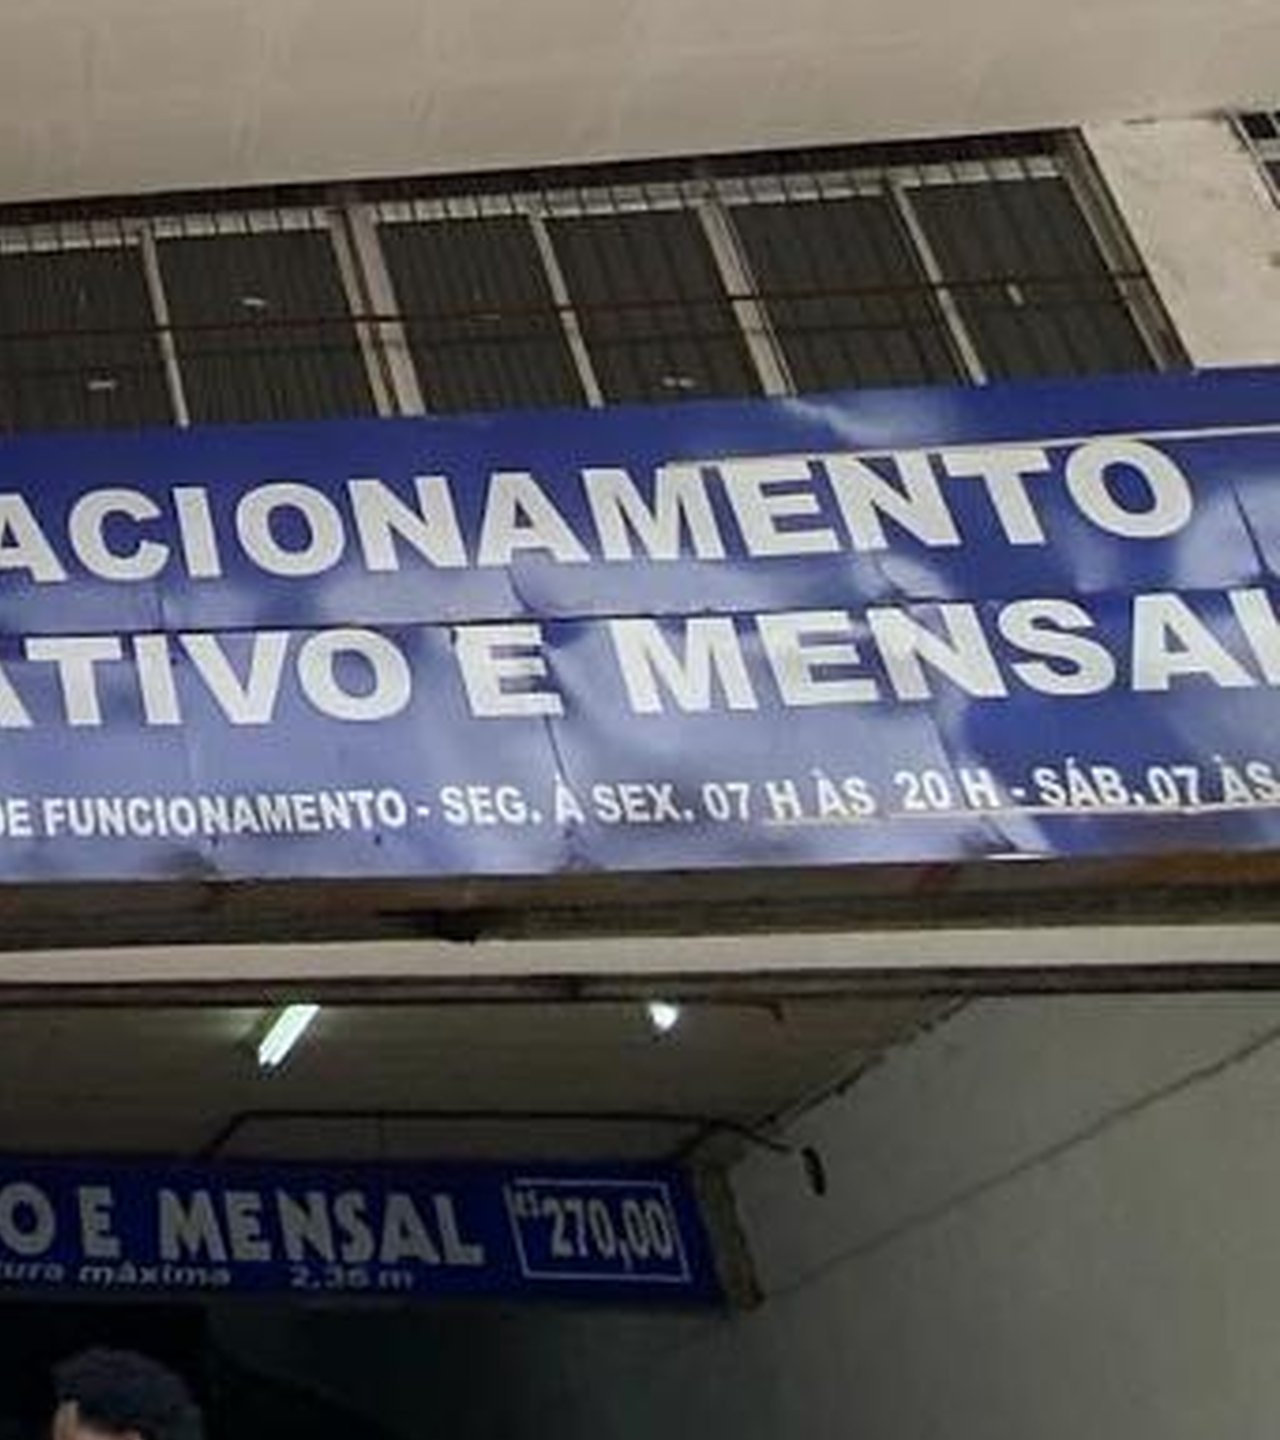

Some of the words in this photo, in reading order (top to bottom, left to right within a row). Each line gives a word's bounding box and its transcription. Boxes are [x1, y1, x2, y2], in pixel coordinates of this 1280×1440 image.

[453, 622, 565, 718] E
[43, 787, 407, 841] FUNCIONAMENTO
[703, 782, 750, 820] 07
[766, 780, 803, 817] H
[894, 769, 952, 810] 20
[959, 768, 1001, 808] H
[1148, 767, 1202, 808] 07
[78, 1185, 121, 1258] E
[157, 1188, 486, 1266] MENSAL
[542, 1197, 676, 1274] 270,00
